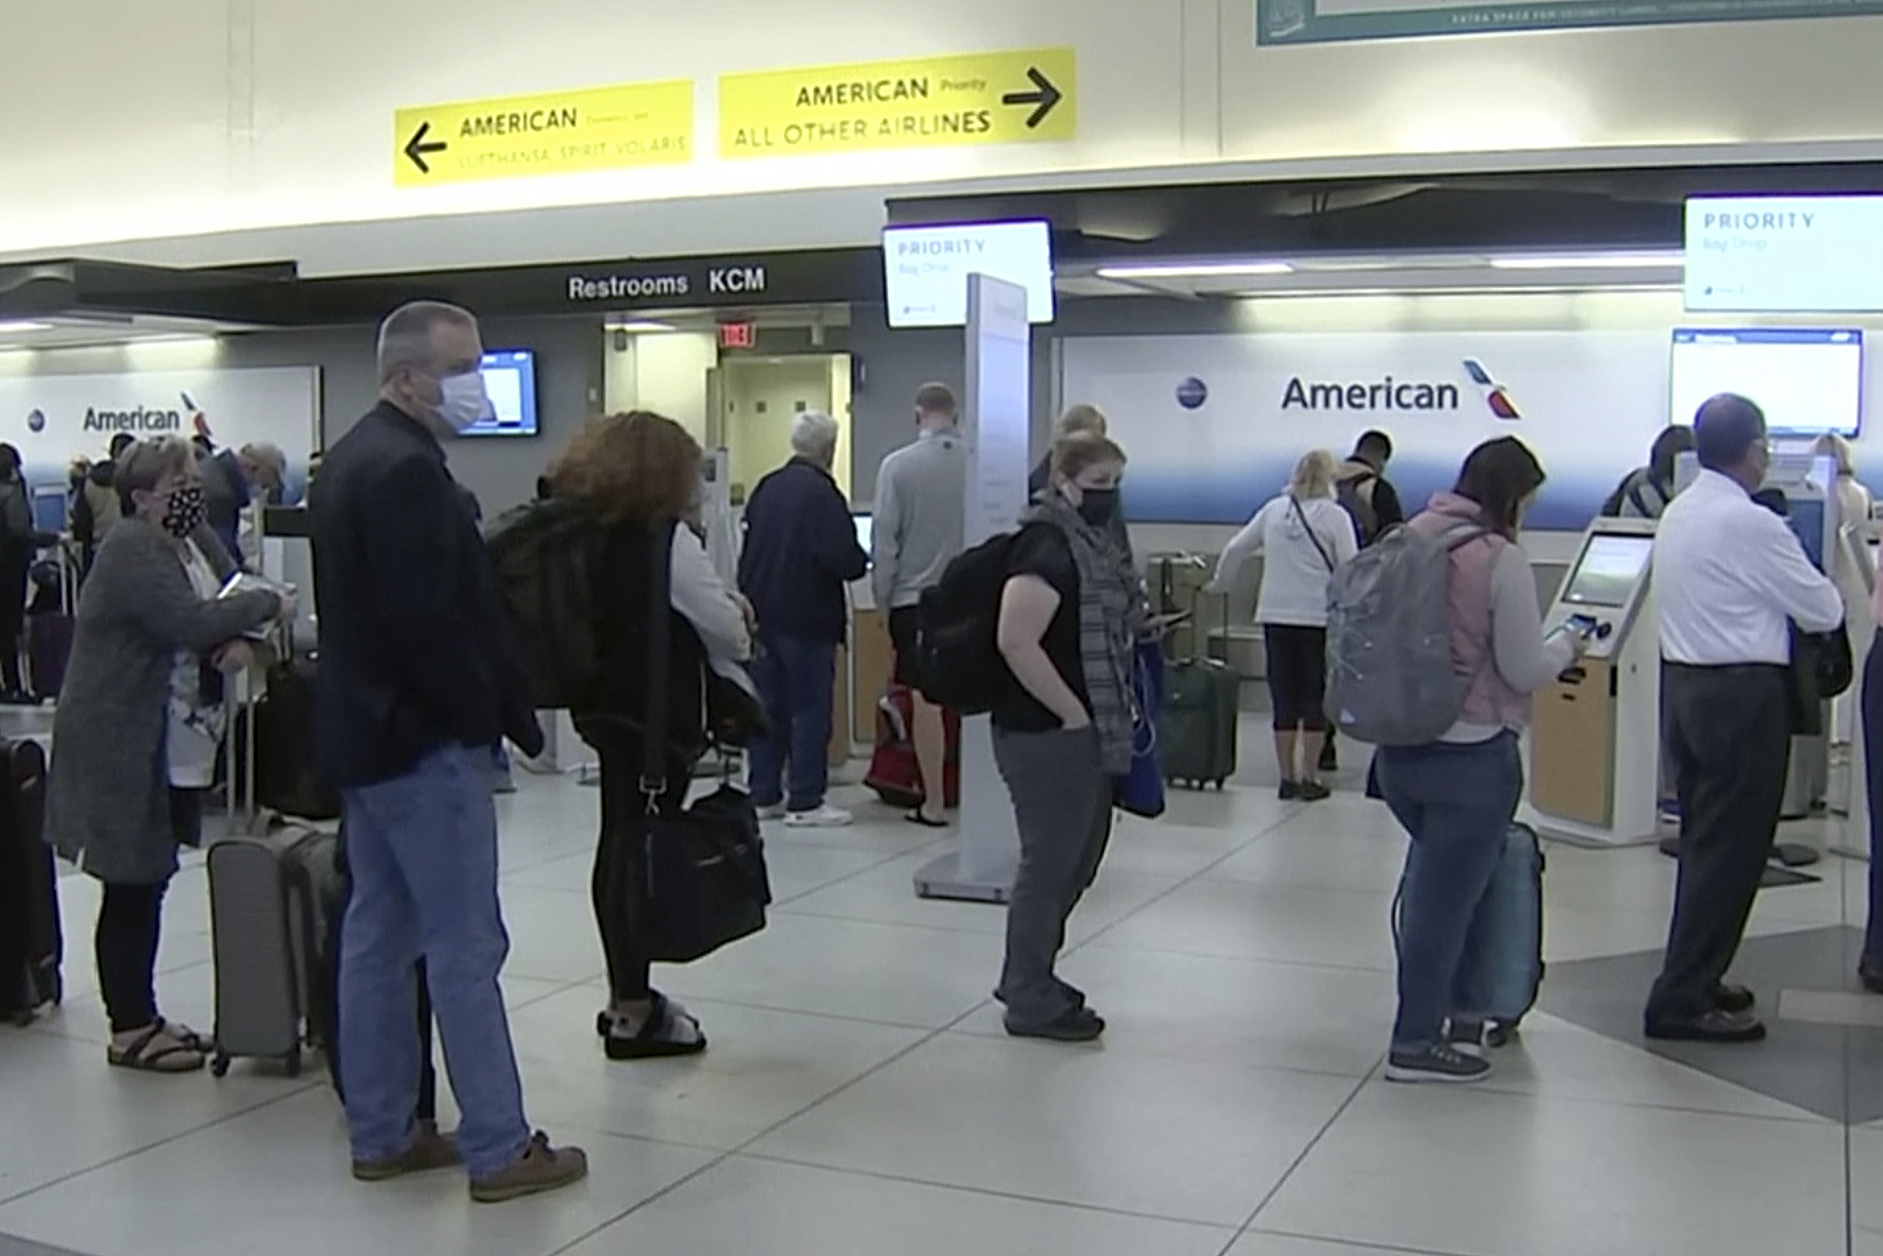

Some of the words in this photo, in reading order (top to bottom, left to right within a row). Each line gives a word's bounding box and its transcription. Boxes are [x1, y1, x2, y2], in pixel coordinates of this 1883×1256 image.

[795, 77, 930, 107] AMERICAN
[459, 106, 578, 138] AMERICAN
[735, 128, 775, 148] ALL
[783, 119, 869, 145] OTHER
[878, 110, 992, 137] AIRLINES
[1704, 211, 1815, 231] PRIORITY
[897, 238, 986, 257] PRIORITY
[568, 274, 689, 299] Restrooms
[708, 266, 766, 292] KCM
[1280, 375, 1460, 410] American
[82, 405, 181, 432] American
